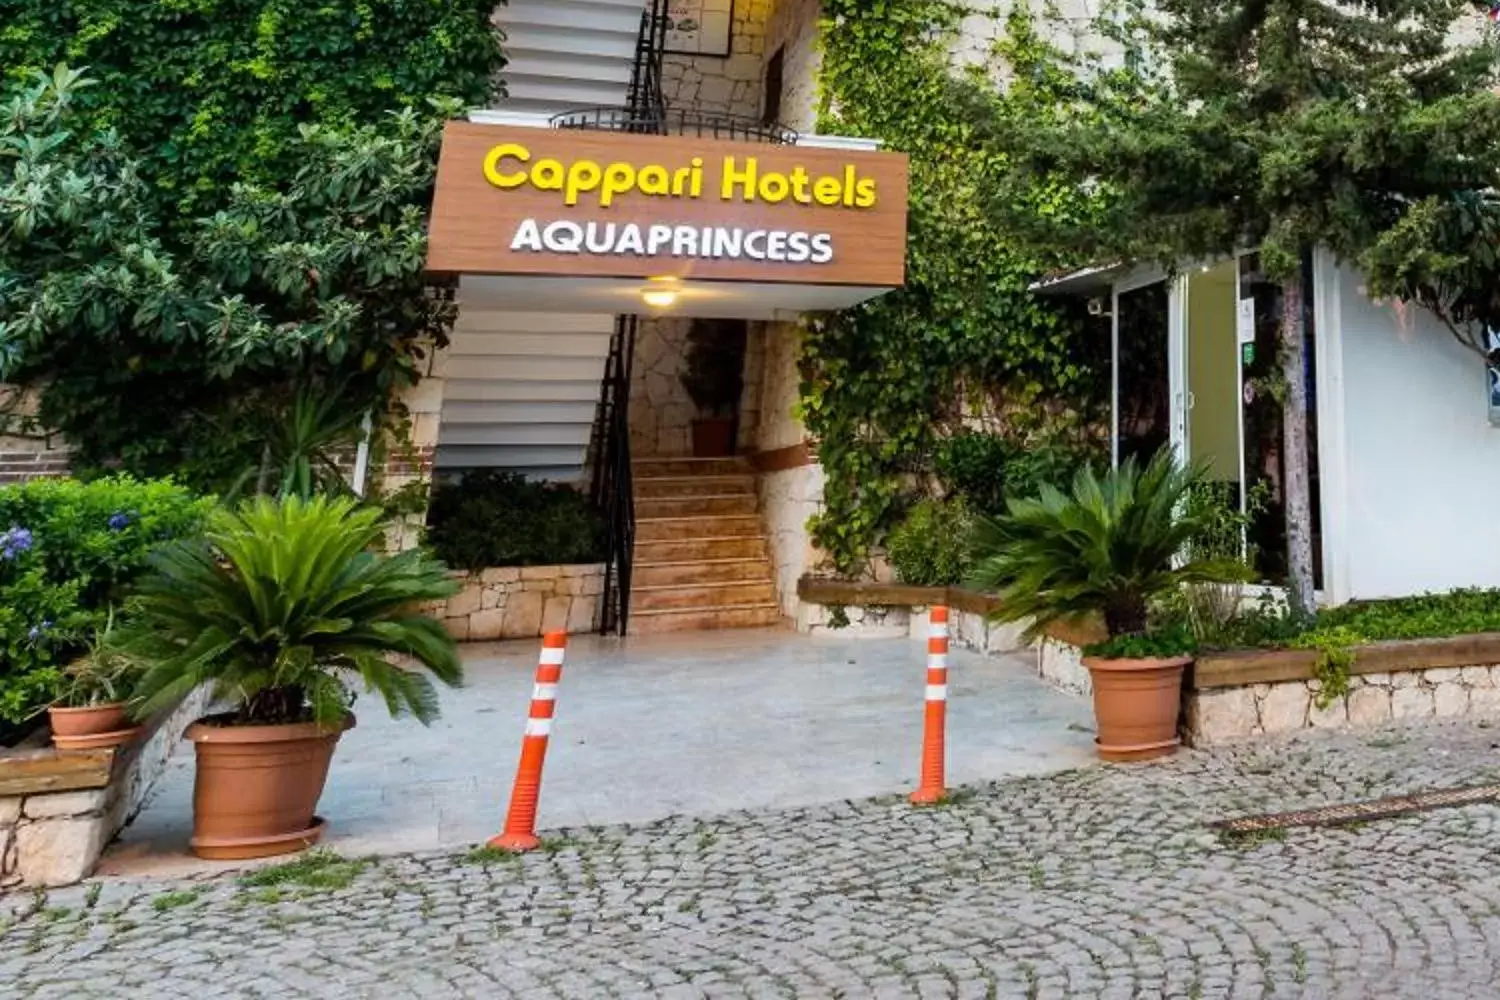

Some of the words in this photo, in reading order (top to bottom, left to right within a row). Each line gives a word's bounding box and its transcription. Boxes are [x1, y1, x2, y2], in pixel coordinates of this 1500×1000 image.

[482, 142, 705, 207] Cappari
[719, 155, 878, 209] Hotels
[508, 217, 834, 264] AQUAPRINCESS
